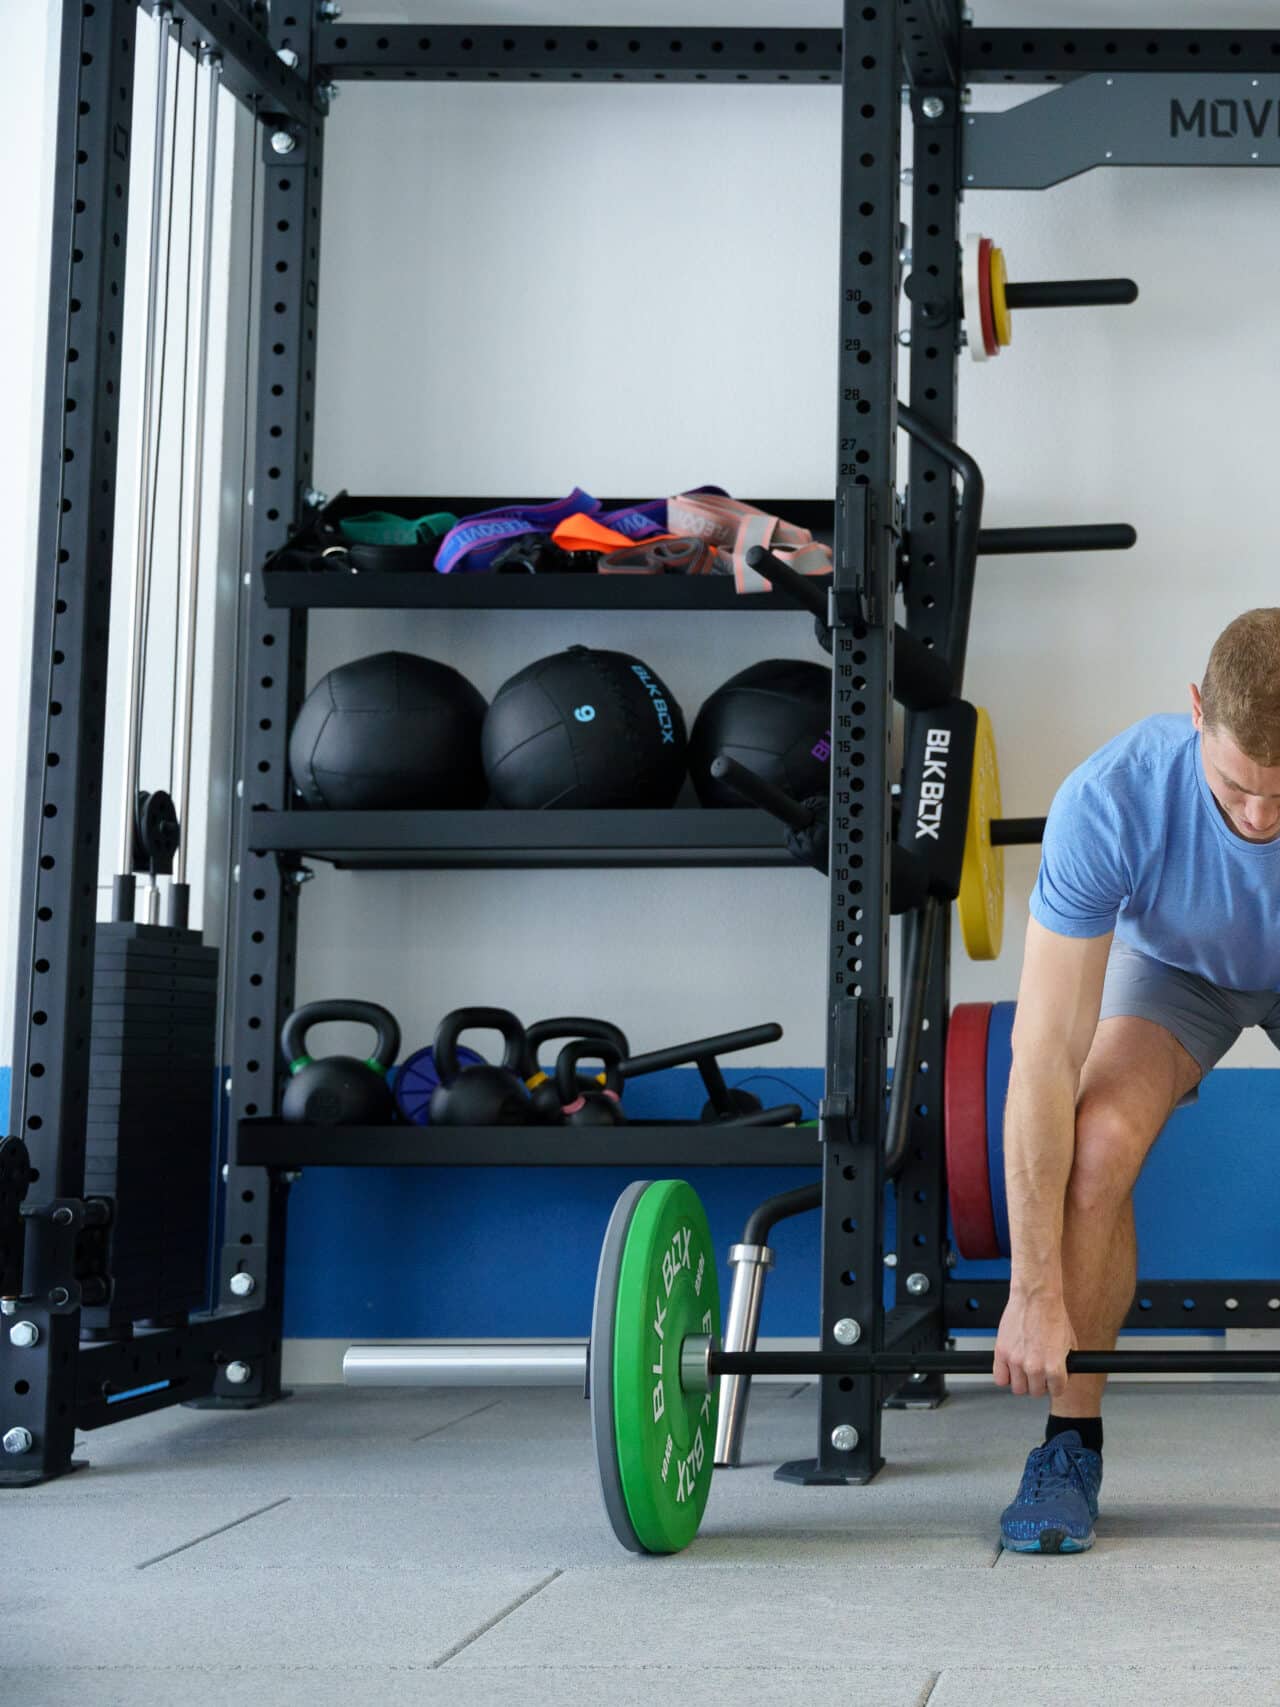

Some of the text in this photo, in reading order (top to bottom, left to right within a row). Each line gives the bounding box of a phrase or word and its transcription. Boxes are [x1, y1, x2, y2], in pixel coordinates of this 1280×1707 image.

[631, 665, 675, 744] BLK BOX
[915, 728, 951, 840] BLK BOX
[653, 1226, 691, 1424] BLK BOX
[676, 1308, 712, 1503] BK BOX
